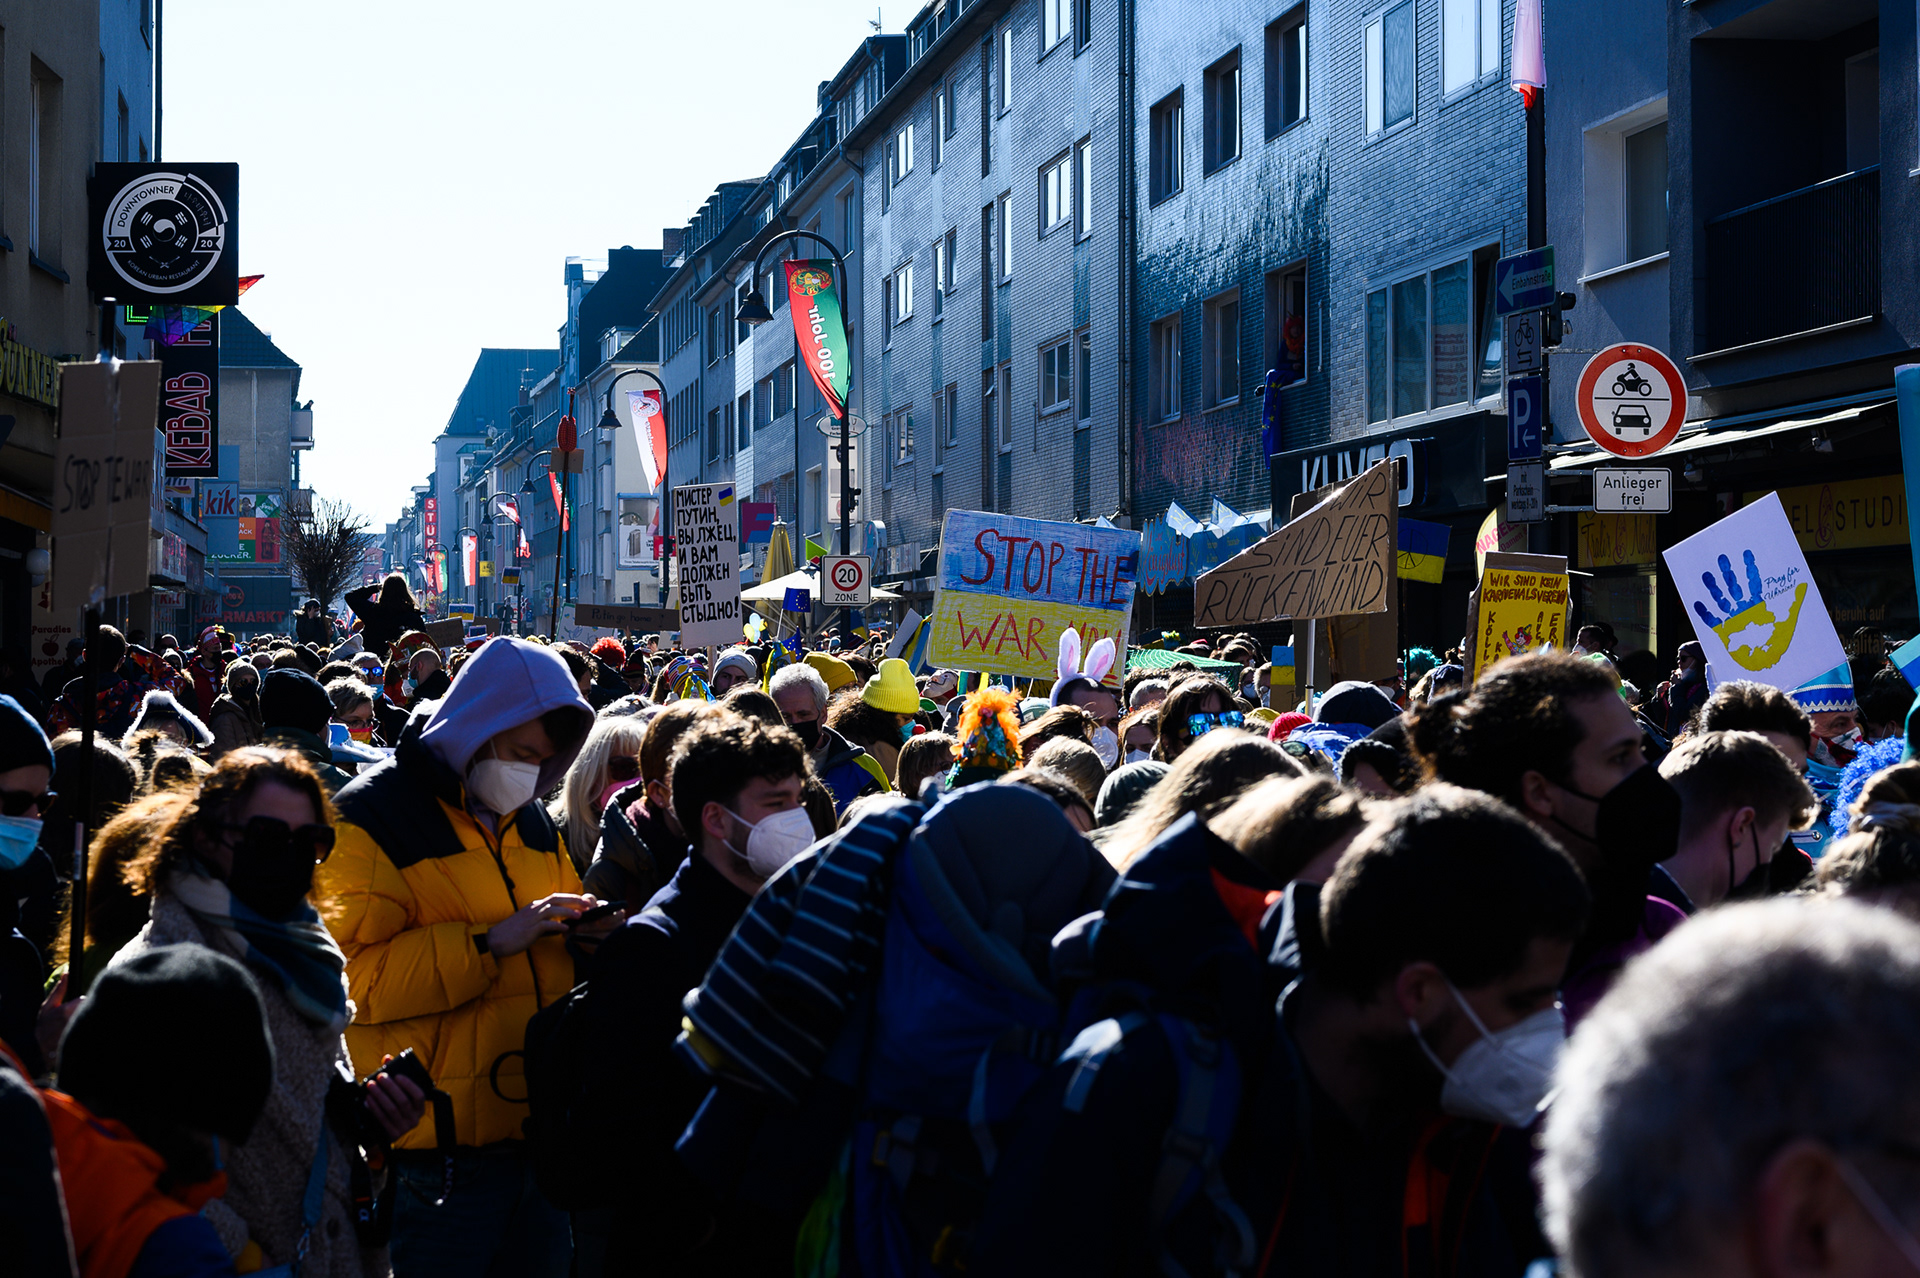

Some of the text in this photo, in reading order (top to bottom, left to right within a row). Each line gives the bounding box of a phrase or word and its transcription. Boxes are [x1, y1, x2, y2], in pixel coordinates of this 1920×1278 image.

[118, 186, 174, 228] DOWNTOWNER
[114, 240, 126, 248] 20
[200, 240, 213, 248] 20
[127, 260, 148, 277] KOREAN
[169, 260, 200, 280] RESTAURANT
[1512, 270, 1552, 290] Einbahnstraße
[166, 372, 212, 468] KEBAB
[1514, 389, 1531, 448] P
[60, 454, 100, 513] STOP
[1603, 476, 1662, 492] Anlieger
[676, 488, 712, 507] МИСТЕР
[1622, 493, 1644, 505] frei
[677, 506, 720, 526] ПУТИН,
[678, 524, 736, 545] ВЫ ЛЖЕЦ,
[1324, 514, 1390, 566] EUER
[1476, 520, 1520, 554] NAGEL
[679, 548, 686, 564] И
[692, 544, 718, 564] ВАМ
[680, 562, 730, 585] ДОЛЖЕН
[838, 568, 856, 582] 20
[960, 528, 1065, 595] STOP
[1075, 547, 1132, 604] THE
[1490, 573, 1562, 588] WIR SIND KEIN
[1764, 566, 1800, 588] Pray for
[680, 584, 712, 604] БЫТЬ
[835, 594, 858, 602] ZONE
[1764, 579, 1796, 600] Ukraine!
[592, 608, 614, 620] Putin
[616, 614, 626, 624] go
[630, 611, 652, 622] home
[682, 596, 739, 623] СТЫДНО!
[1835, 604, 1885, 621] beruht auf
[32, 626, 71, 634] Paradies
[958, 610, 1048, 661] WAR
